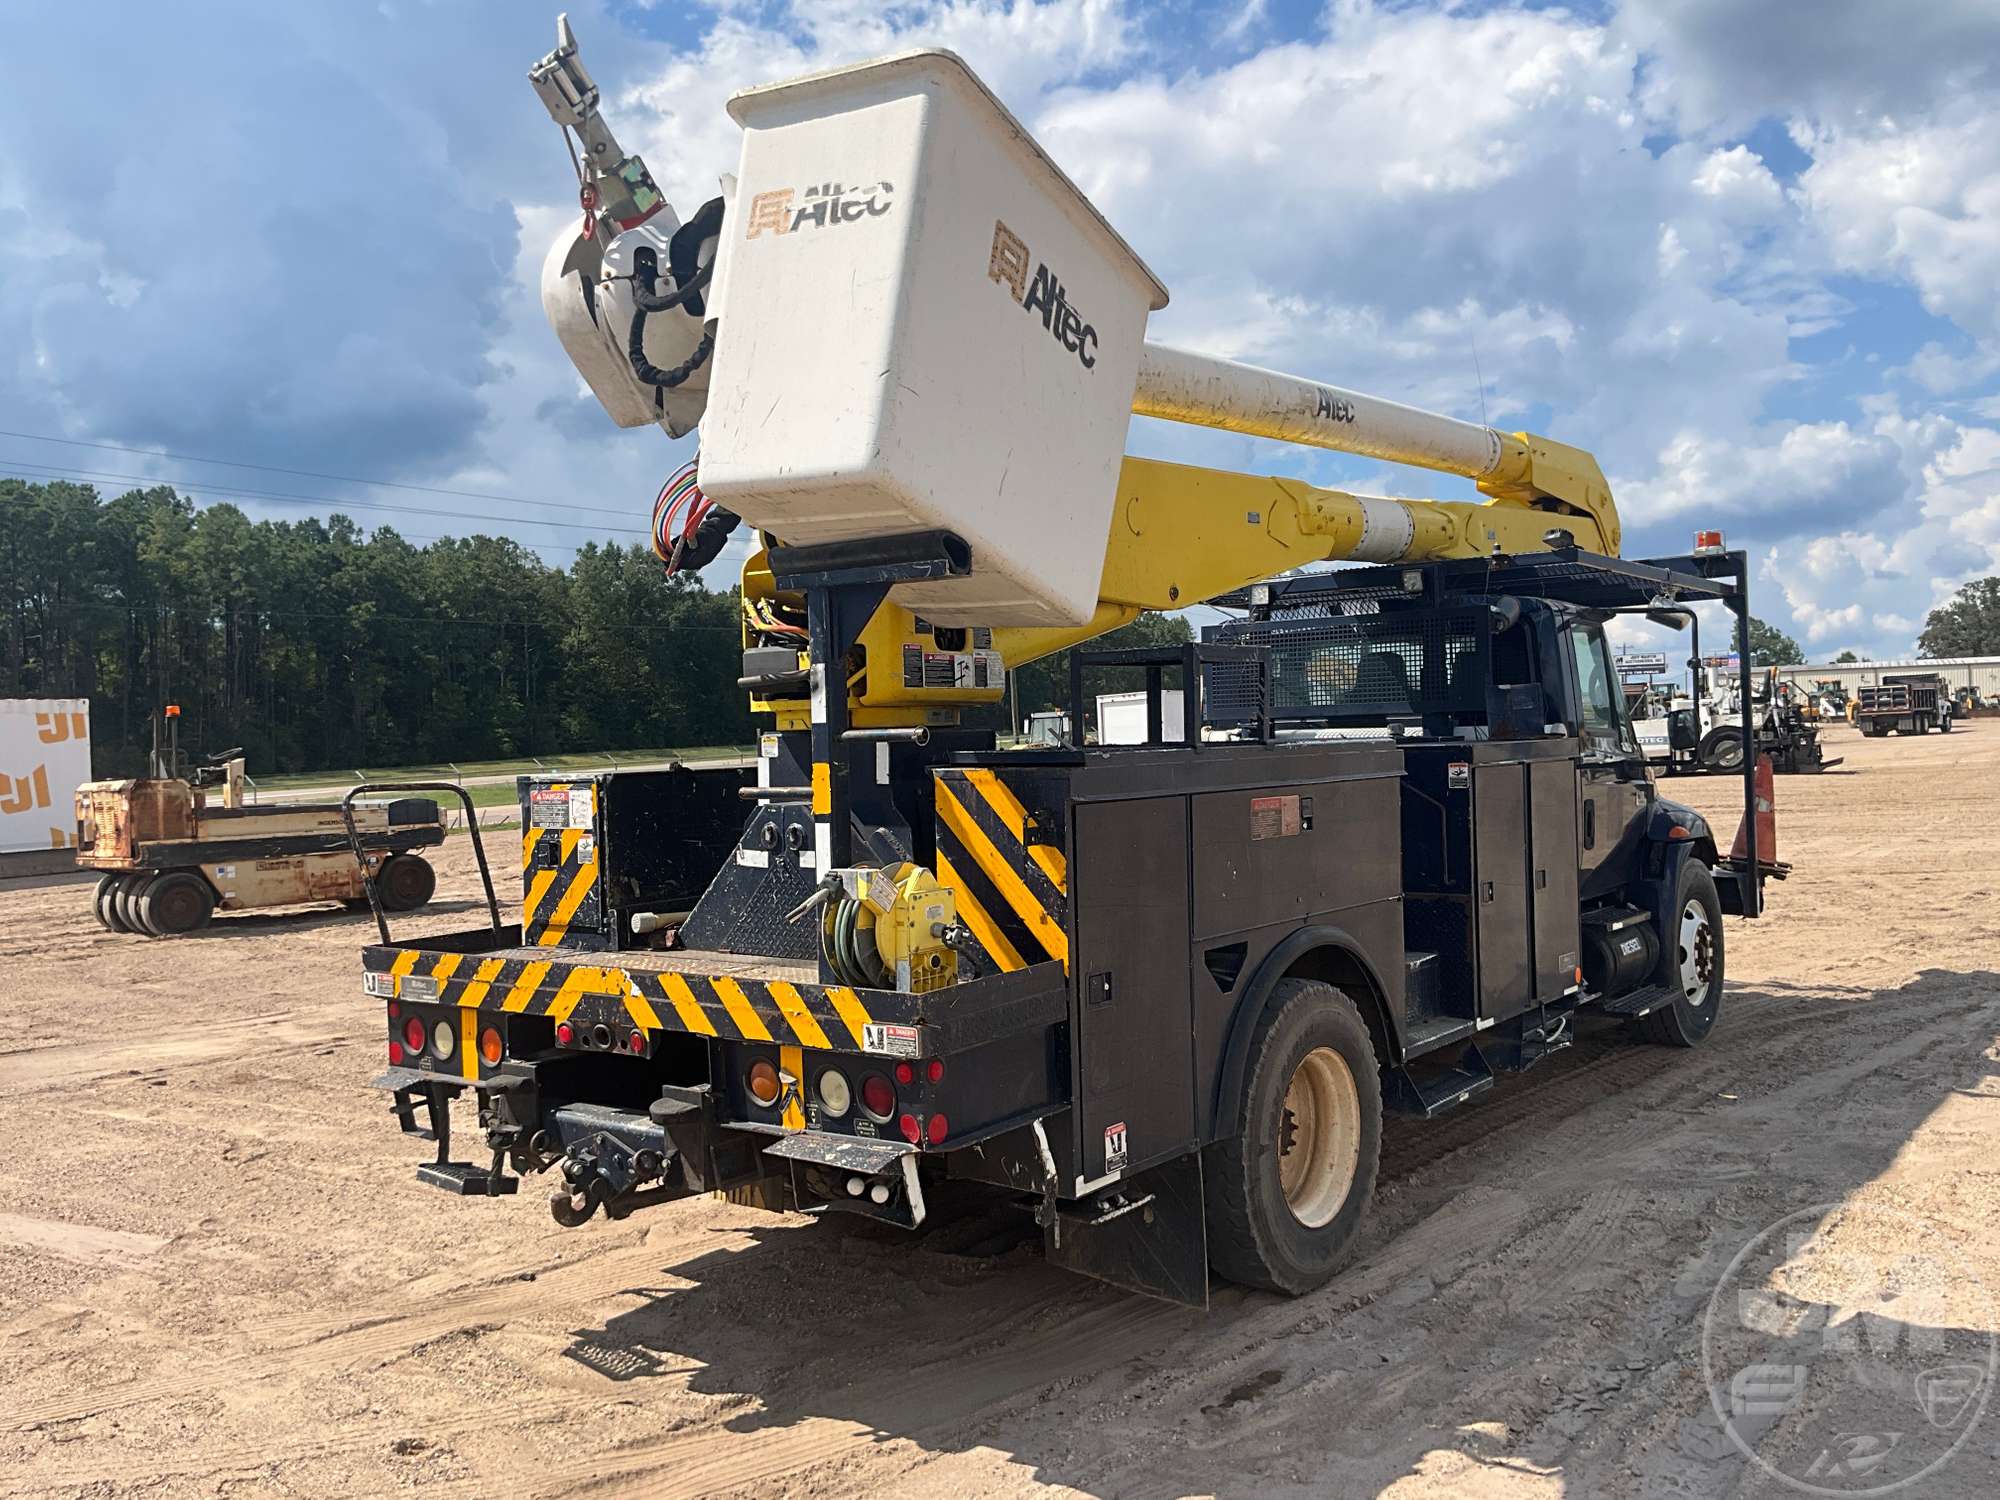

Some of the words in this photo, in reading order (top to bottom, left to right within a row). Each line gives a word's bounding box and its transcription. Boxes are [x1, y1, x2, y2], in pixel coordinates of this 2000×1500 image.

[1023, 263, 1098, 369] Altec
[1317, 387, 1355, 423] Altec
[542, 792, 565, 801] DANGER
